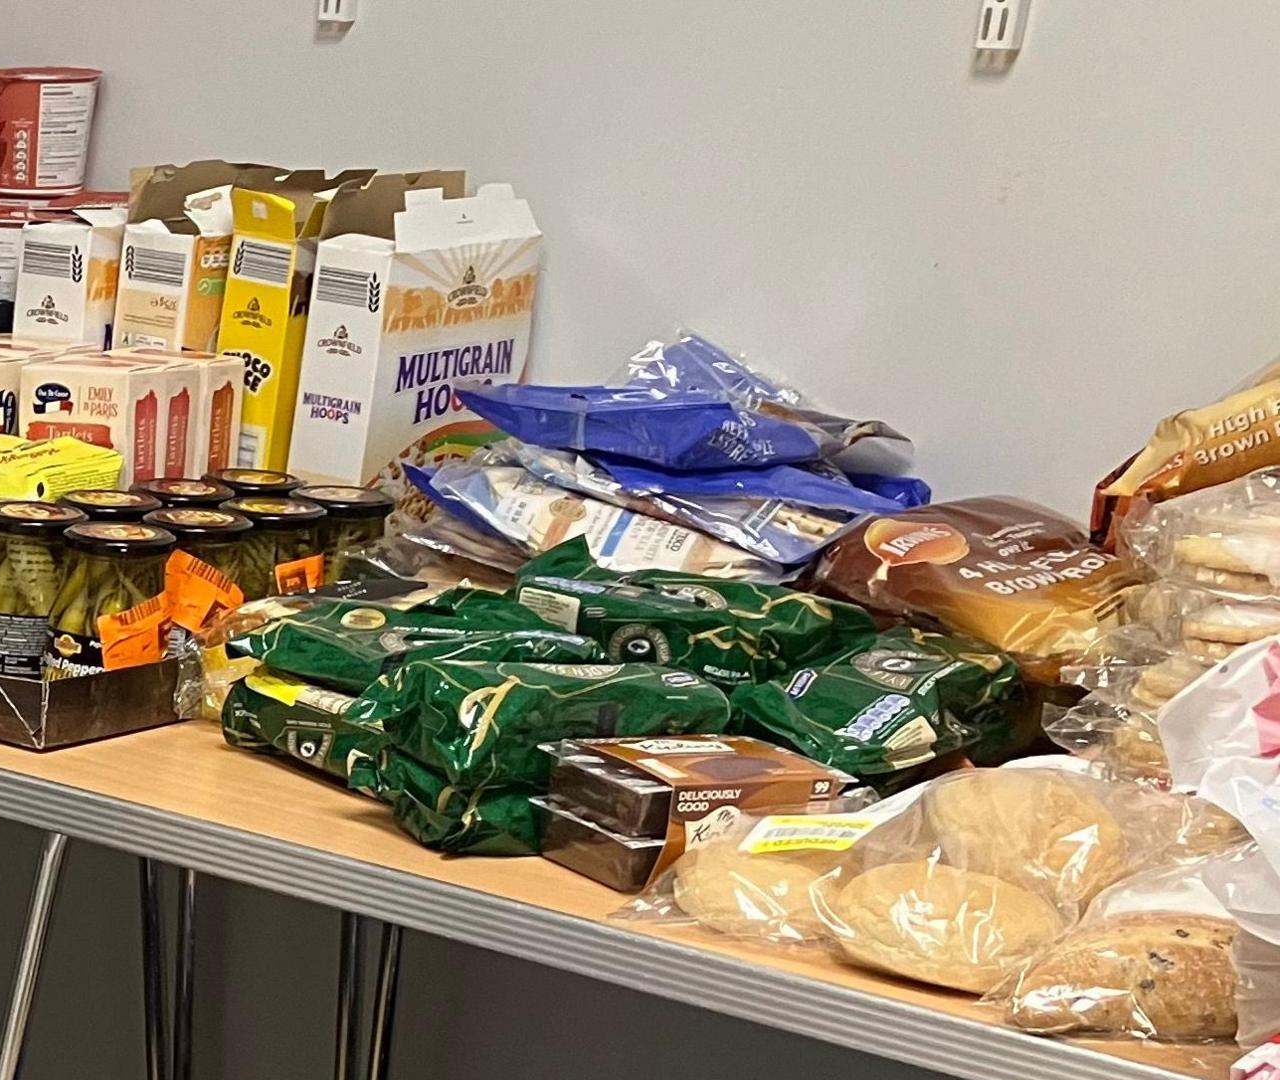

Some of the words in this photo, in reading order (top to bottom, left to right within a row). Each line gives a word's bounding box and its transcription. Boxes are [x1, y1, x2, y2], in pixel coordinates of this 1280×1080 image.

[394, 339, 514, 394] MULTIGRAIN
[88, 386, 113, 402] EMILY
[90, 401, 119, 418] PARIS
[303, 392, 362, 415] MULTIGRAIN
[311, 406, 349, 425] HOOPS
[1209, 406, 1266, 438] High
[678, 788, 742, 802] DELICIOUSLY
[813, 781, 831, 795] 99
[677, 802, 710, 813] GOOD
